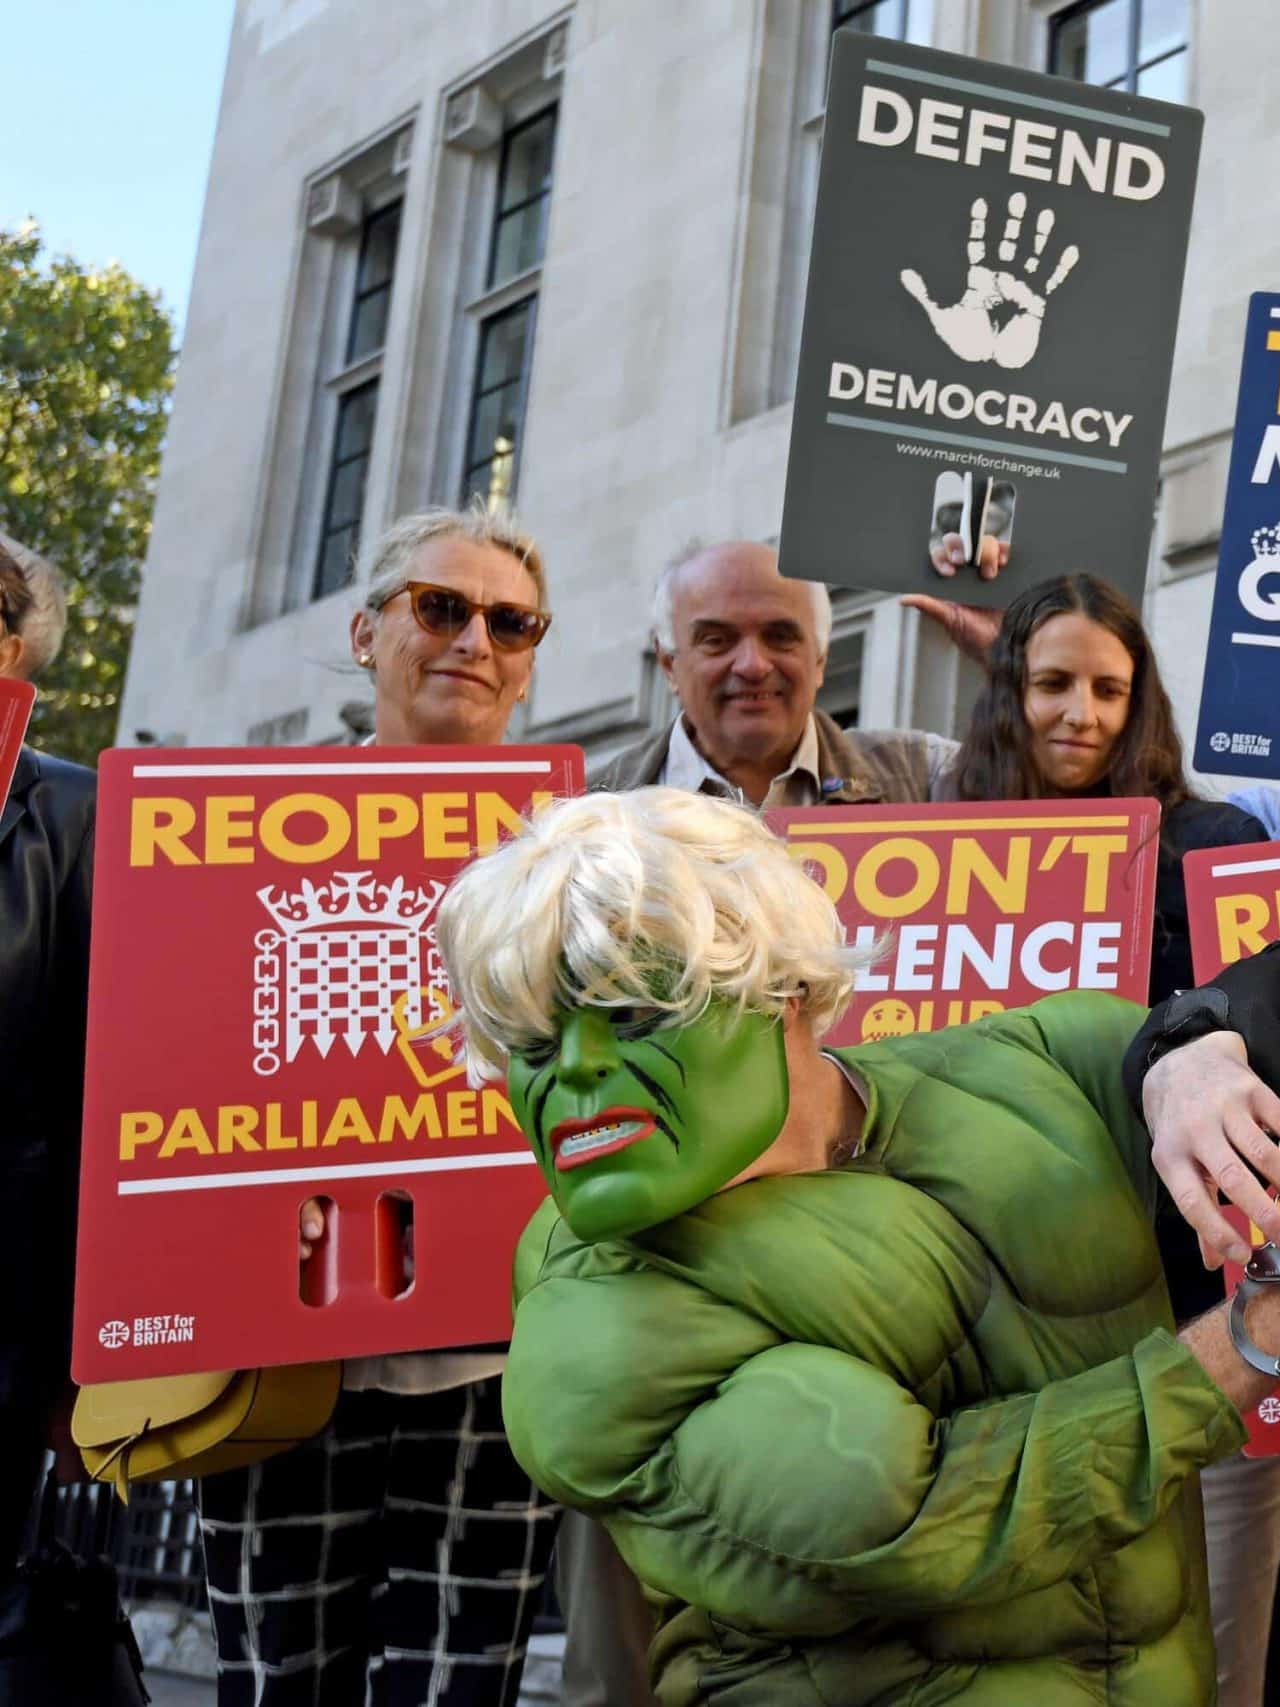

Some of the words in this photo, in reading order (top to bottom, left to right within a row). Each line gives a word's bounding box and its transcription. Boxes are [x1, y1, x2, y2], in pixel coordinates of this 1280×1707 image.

[857, 86, 1165, 200] DEFEND
[828, 362, 1133, 447] DEMOCRACY
[896, 441, 1061, 480] www.marchforchange.uk
[1231, 743, 1270, 756] BRITAIN
[1232, 733, 1257, 746] BEST
[1257, 734, 1272, 747] for
[129, 791, 553, 868] REOPEN
[842, 921, 1122, 992] LENCE
[118, 1089, 523, 1161] PARLIAMEN
[133, 1327, 193, 1347] BRITAIN
[134, 1315, 171, 1332] BEST
[174, 1313, 195, 1329] for
